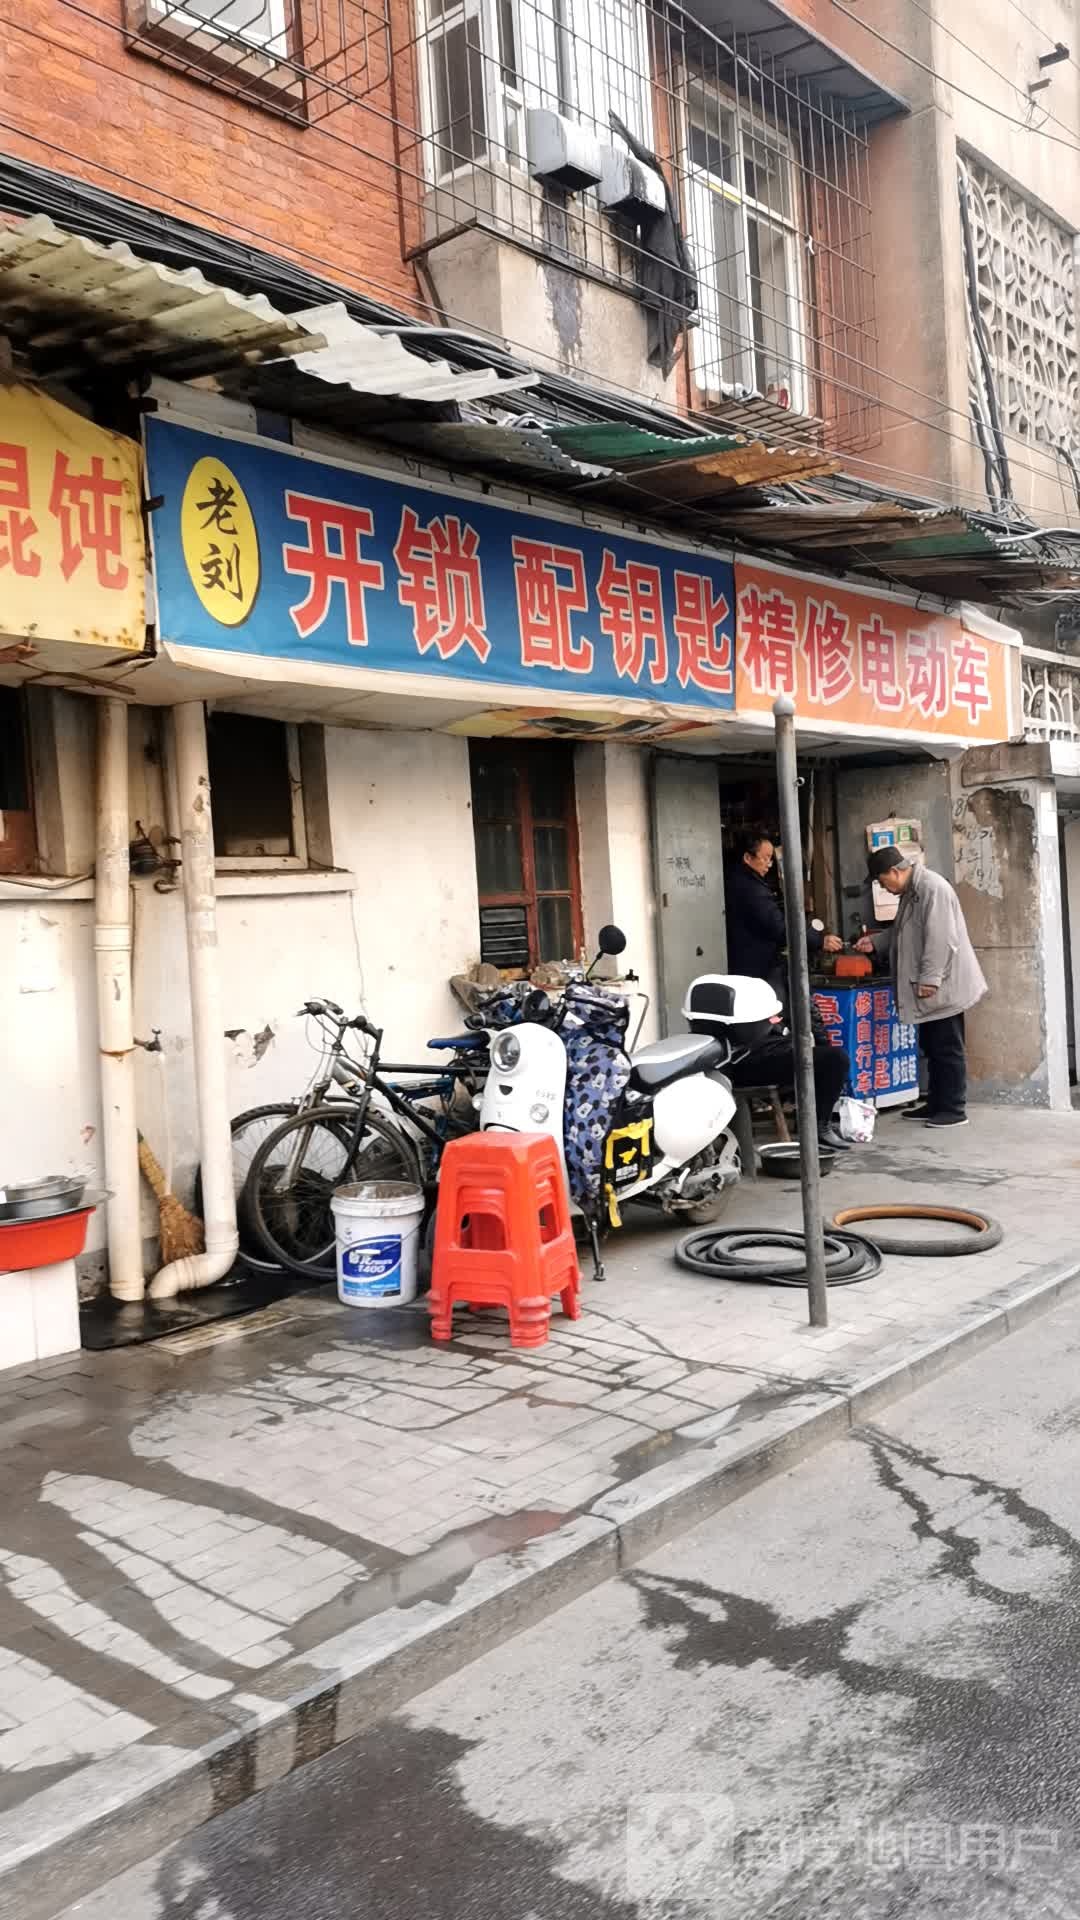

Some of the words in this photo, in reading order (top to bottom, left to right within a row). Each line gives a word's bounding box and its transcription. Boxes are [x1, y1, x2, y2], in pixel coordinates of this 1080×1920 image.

[196, 477, 246, 603] 老刘
[281, 488, 492, 664] 开锁
[511, 534, 734, 694] 配钥匙
[737, 583, 993, 727] 精修电动车
[855, 991, 873, 1095] 修自行车
[874, 990, 891, 1089] 配钥匙
